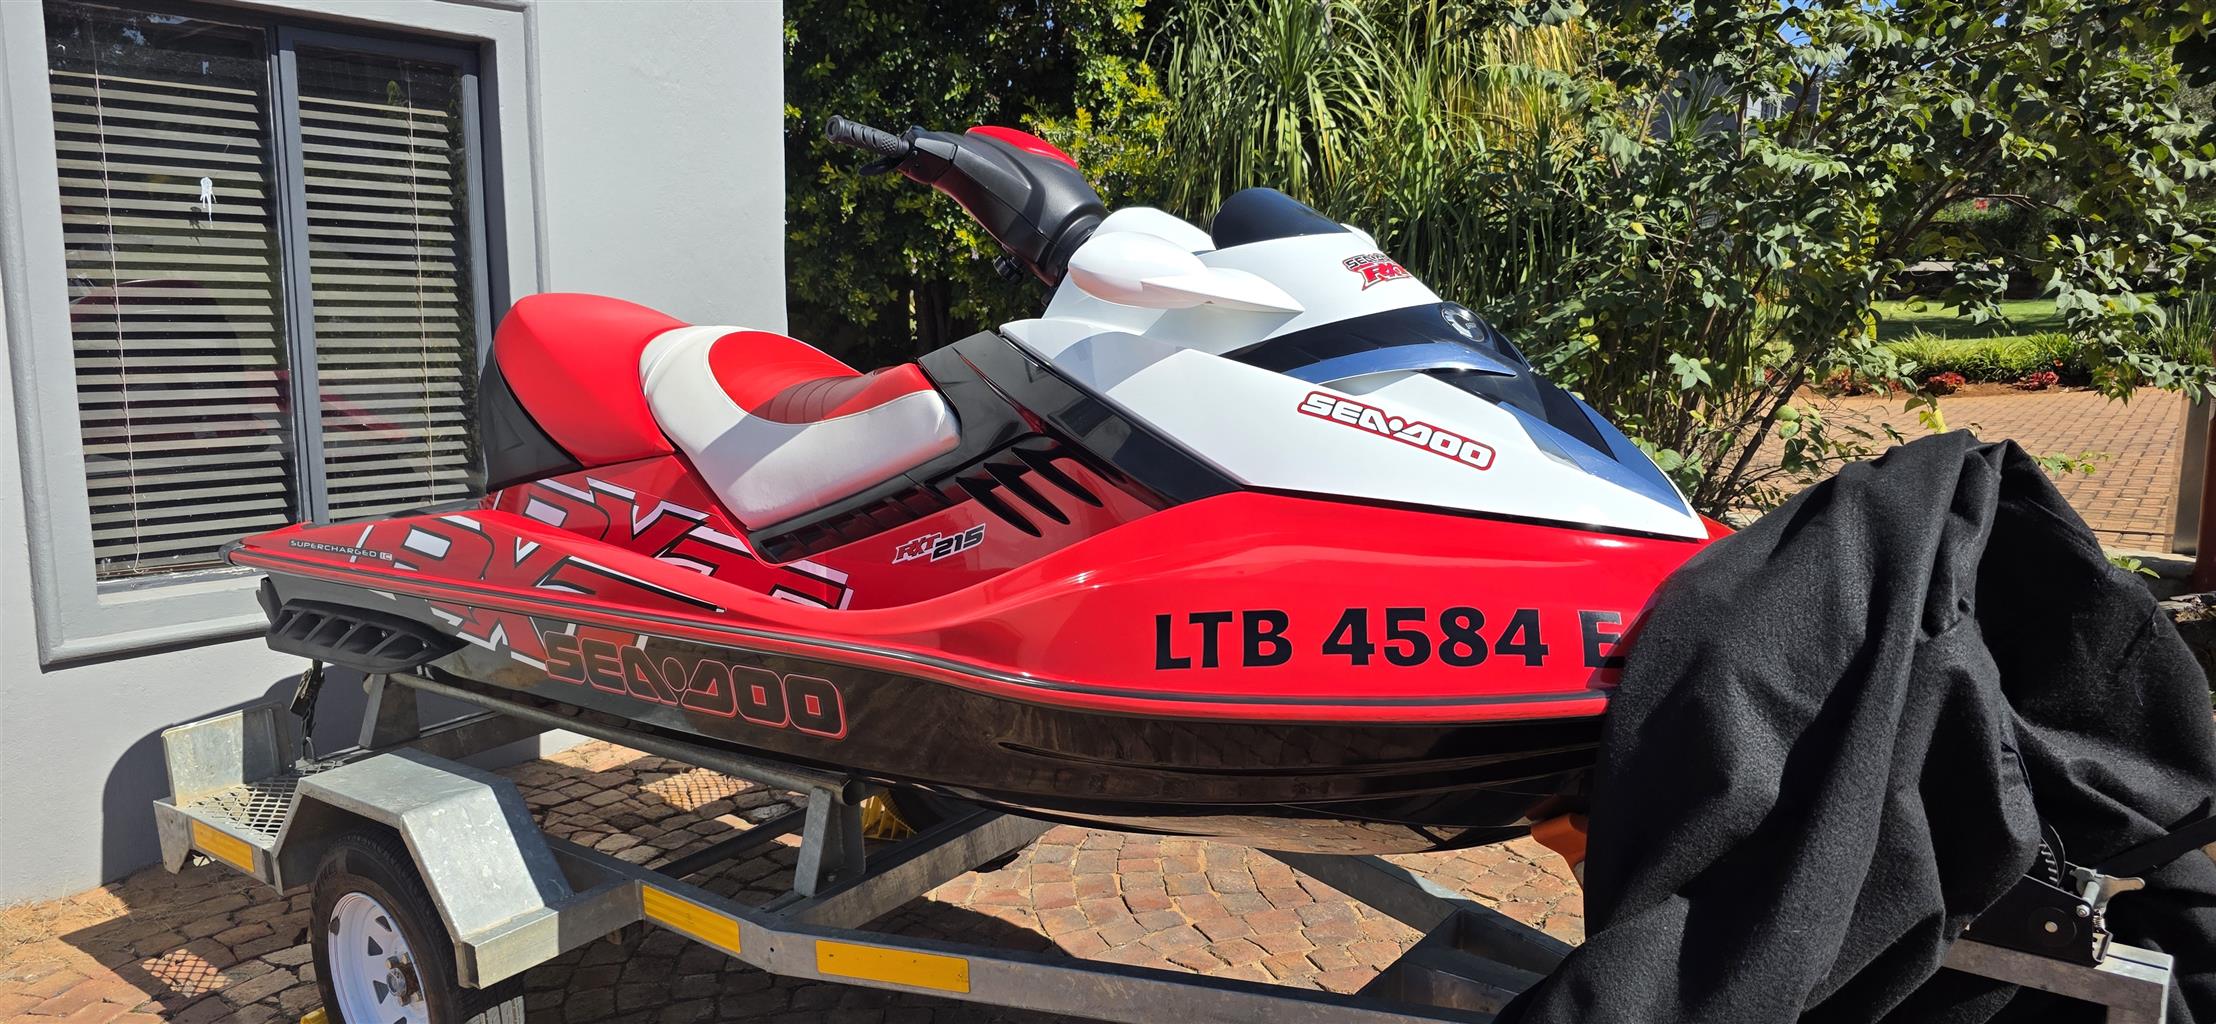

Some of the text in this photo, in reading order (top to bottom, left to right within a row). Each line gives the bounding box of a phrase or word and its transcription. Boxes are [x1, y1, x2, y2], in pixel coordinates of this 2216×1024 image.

[289, 539, 378, 558] SUPERCHARGED
[931, 523, 986, 561] 215
[1155, 606, 1626, 670] LTB 4584 E
